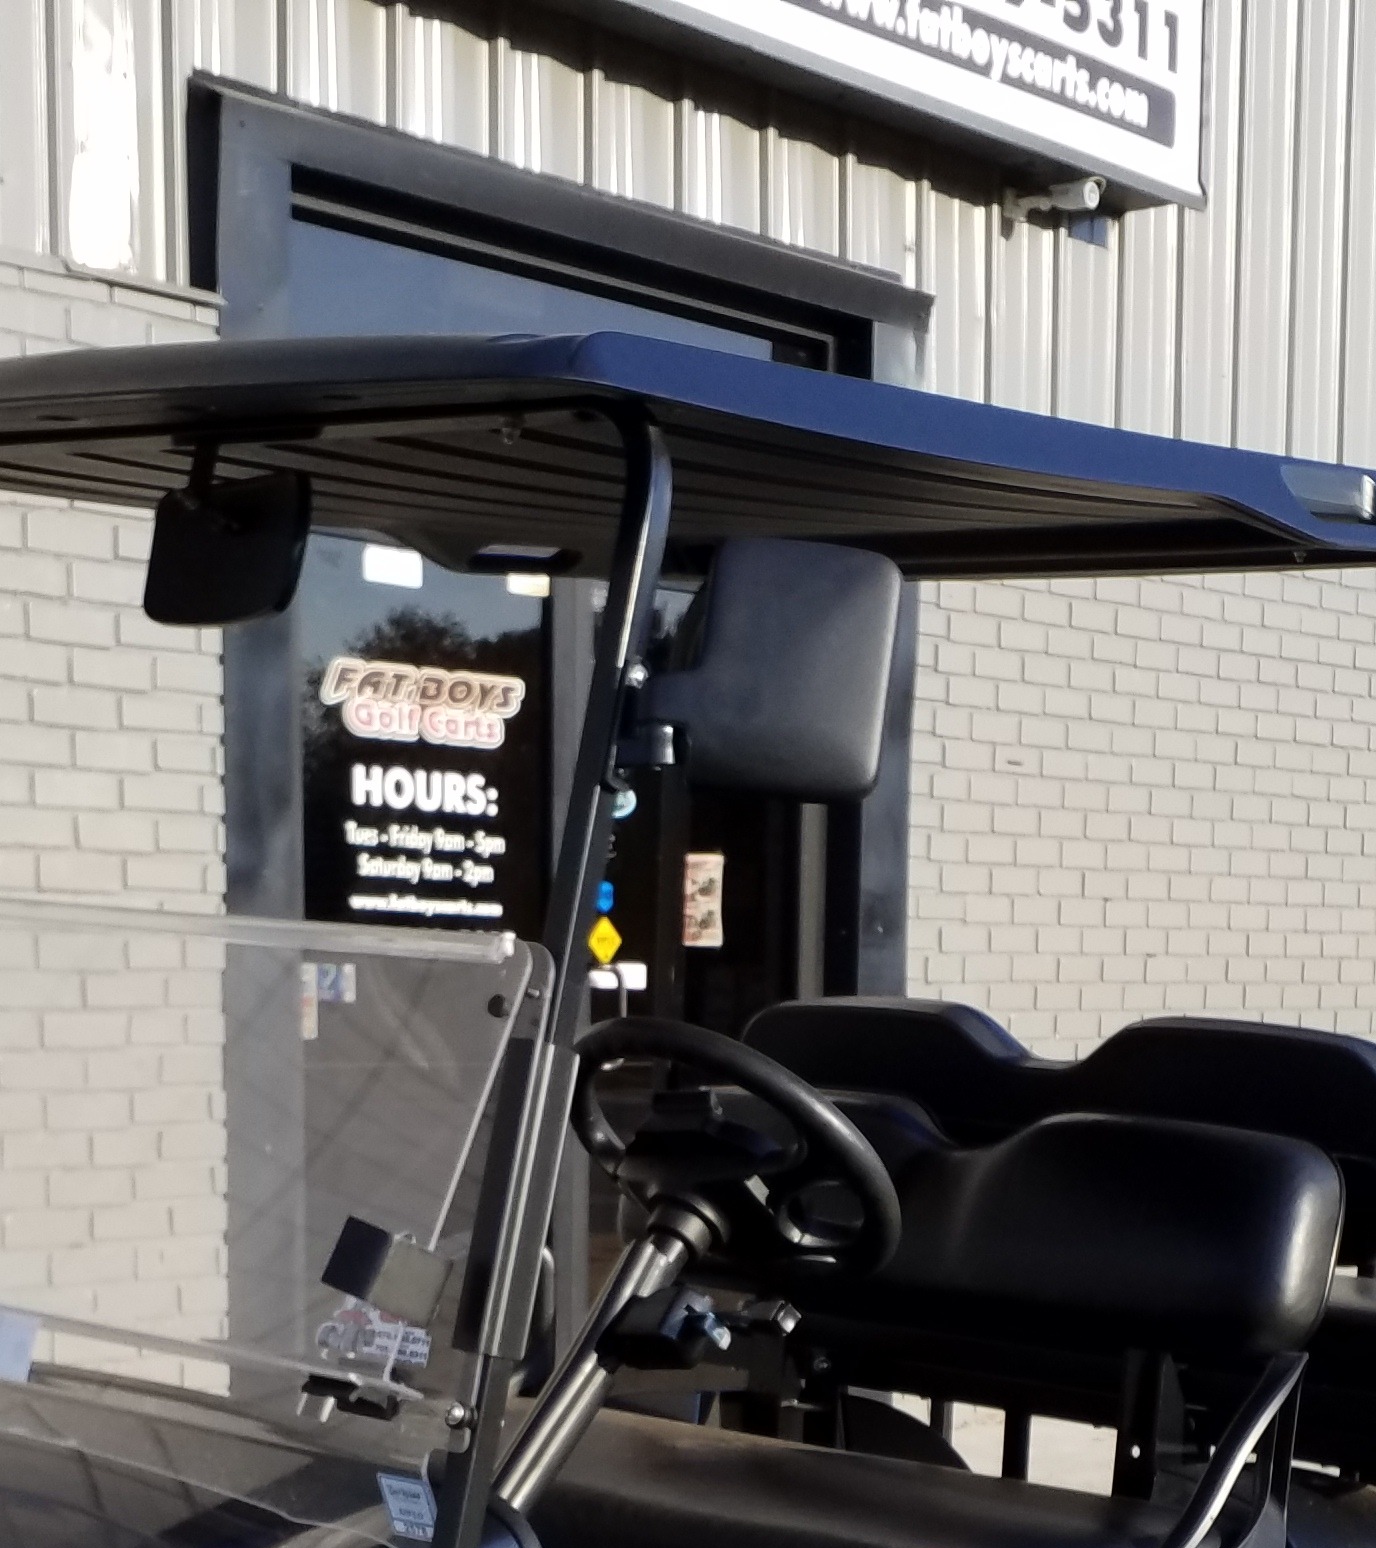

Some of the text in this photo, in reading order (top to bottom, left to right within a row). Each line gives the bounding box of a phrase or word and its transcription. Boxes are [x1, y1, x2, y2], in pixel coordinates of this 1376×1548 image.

[819, 0, 1149, 128] ww.fatboyscarts.com
[330, 664, 518, 711] FAT BOYS
[350, 701, 502, 743] Golf Carts
[351, 763, 499, 817] HOURS:
[344, 820, 379, 846] Tues
[388, 823, 433, 855] Friday
[432, 827, 465, 853] 9am
[473, 830, 506, 858] 5pm
[357, 852, 421, 885] Saturday
[421, 857, 453, 881] 9am
[462, 859, 495, 888] 2pm
